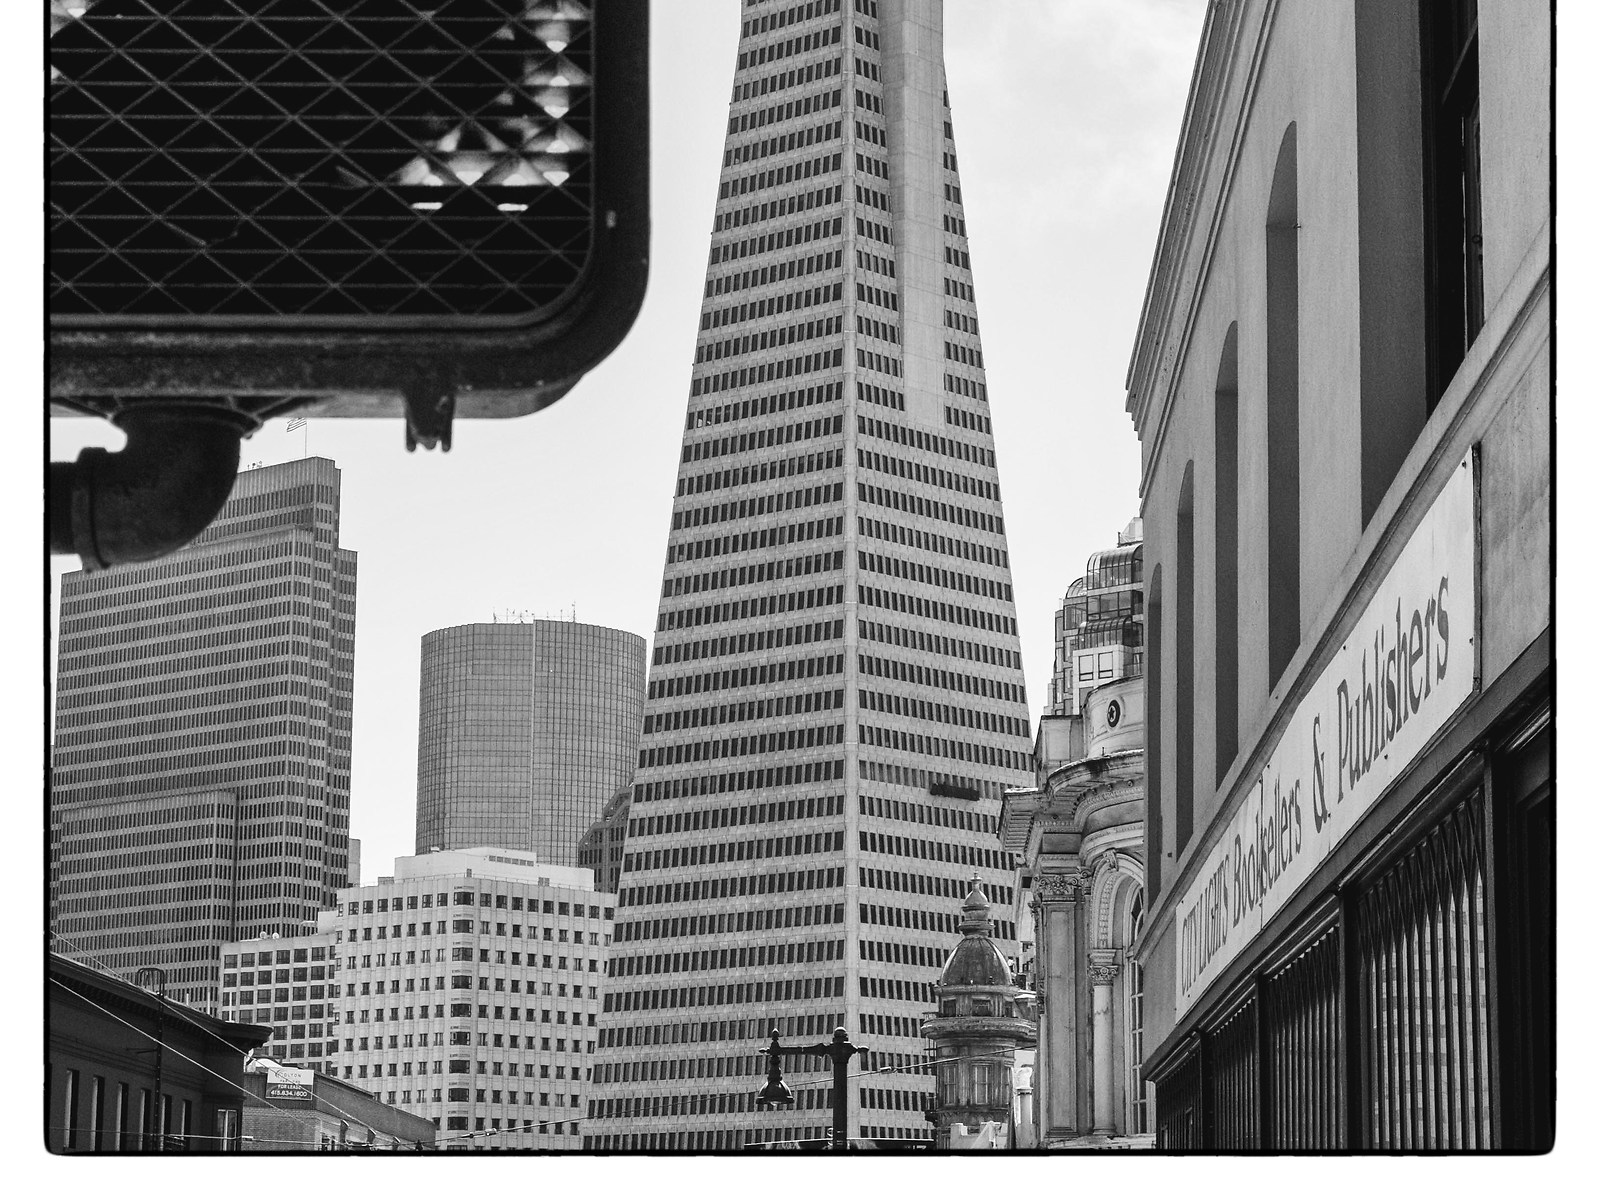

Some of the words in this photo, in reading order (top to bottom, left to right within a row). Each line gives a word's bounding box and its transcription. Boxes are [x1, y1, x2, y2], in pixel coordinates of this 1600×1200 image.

[1182, 902, 1199, 996] CITY
[1200, 854, 1229, 974] LIGHTS
[1233, 773, 1302, 929] Booksellers
[1313, 712, 1328, 834] &
[1337, 575, 1449, 804] Publishers
